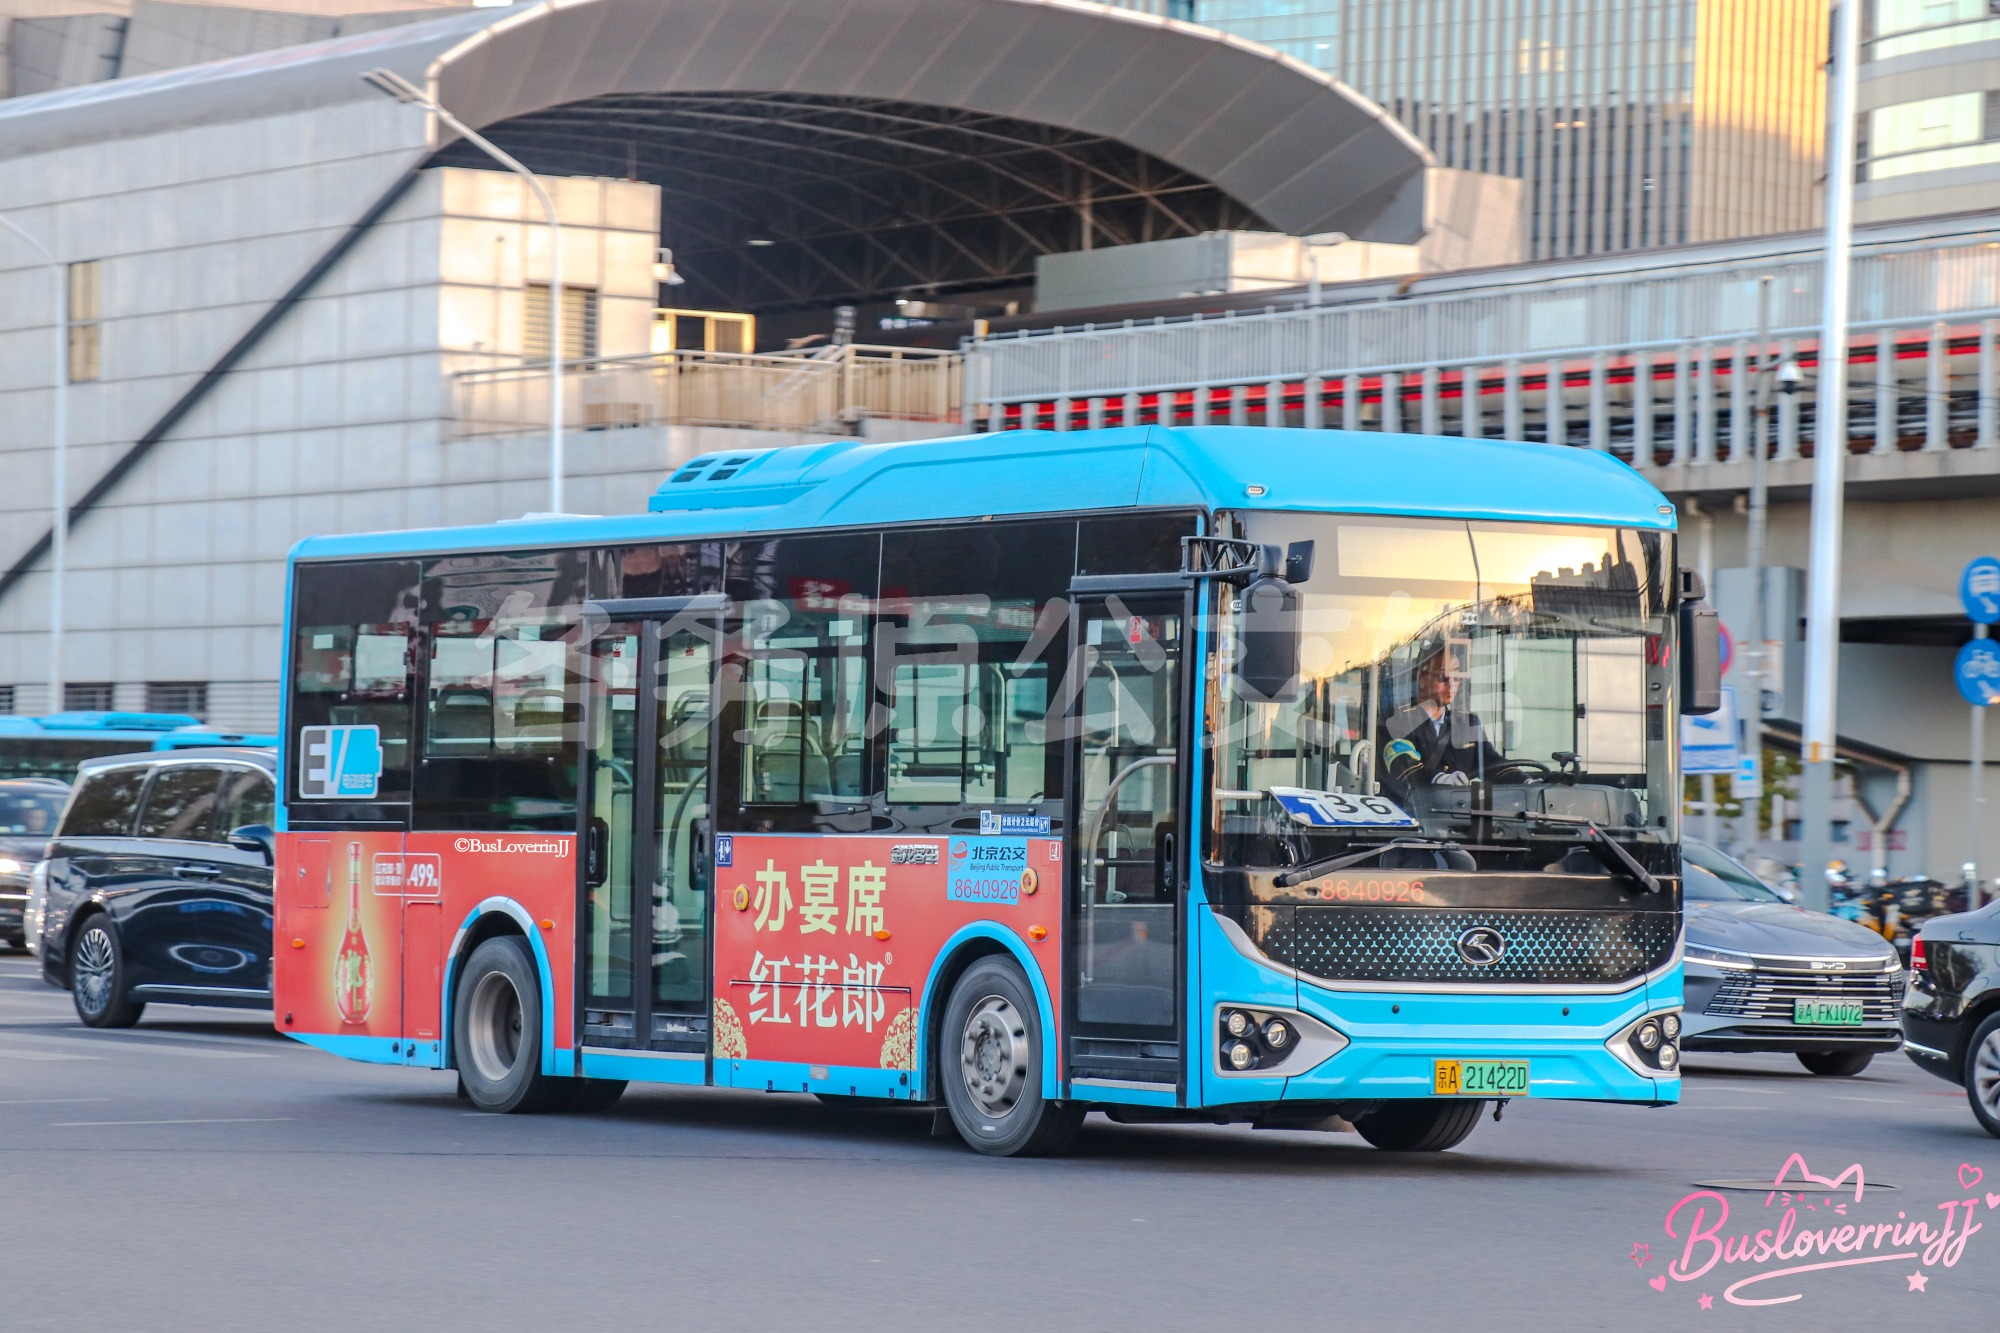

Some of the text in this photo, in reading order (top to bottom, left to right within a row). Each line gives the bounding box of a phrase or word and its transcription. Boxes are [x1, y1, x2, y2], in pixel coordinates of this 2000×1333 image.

[972, 846, 1026, 861] 北京公交
[970, 863, 1024, 873] Beijing Public Transport
[753, 858, 887, 937] 办宴席
[954, 878, 1018, 900] 8640926
[1320, 879, 1425, 903] 8640926
[1809, 961, 1848, 971] BYD
